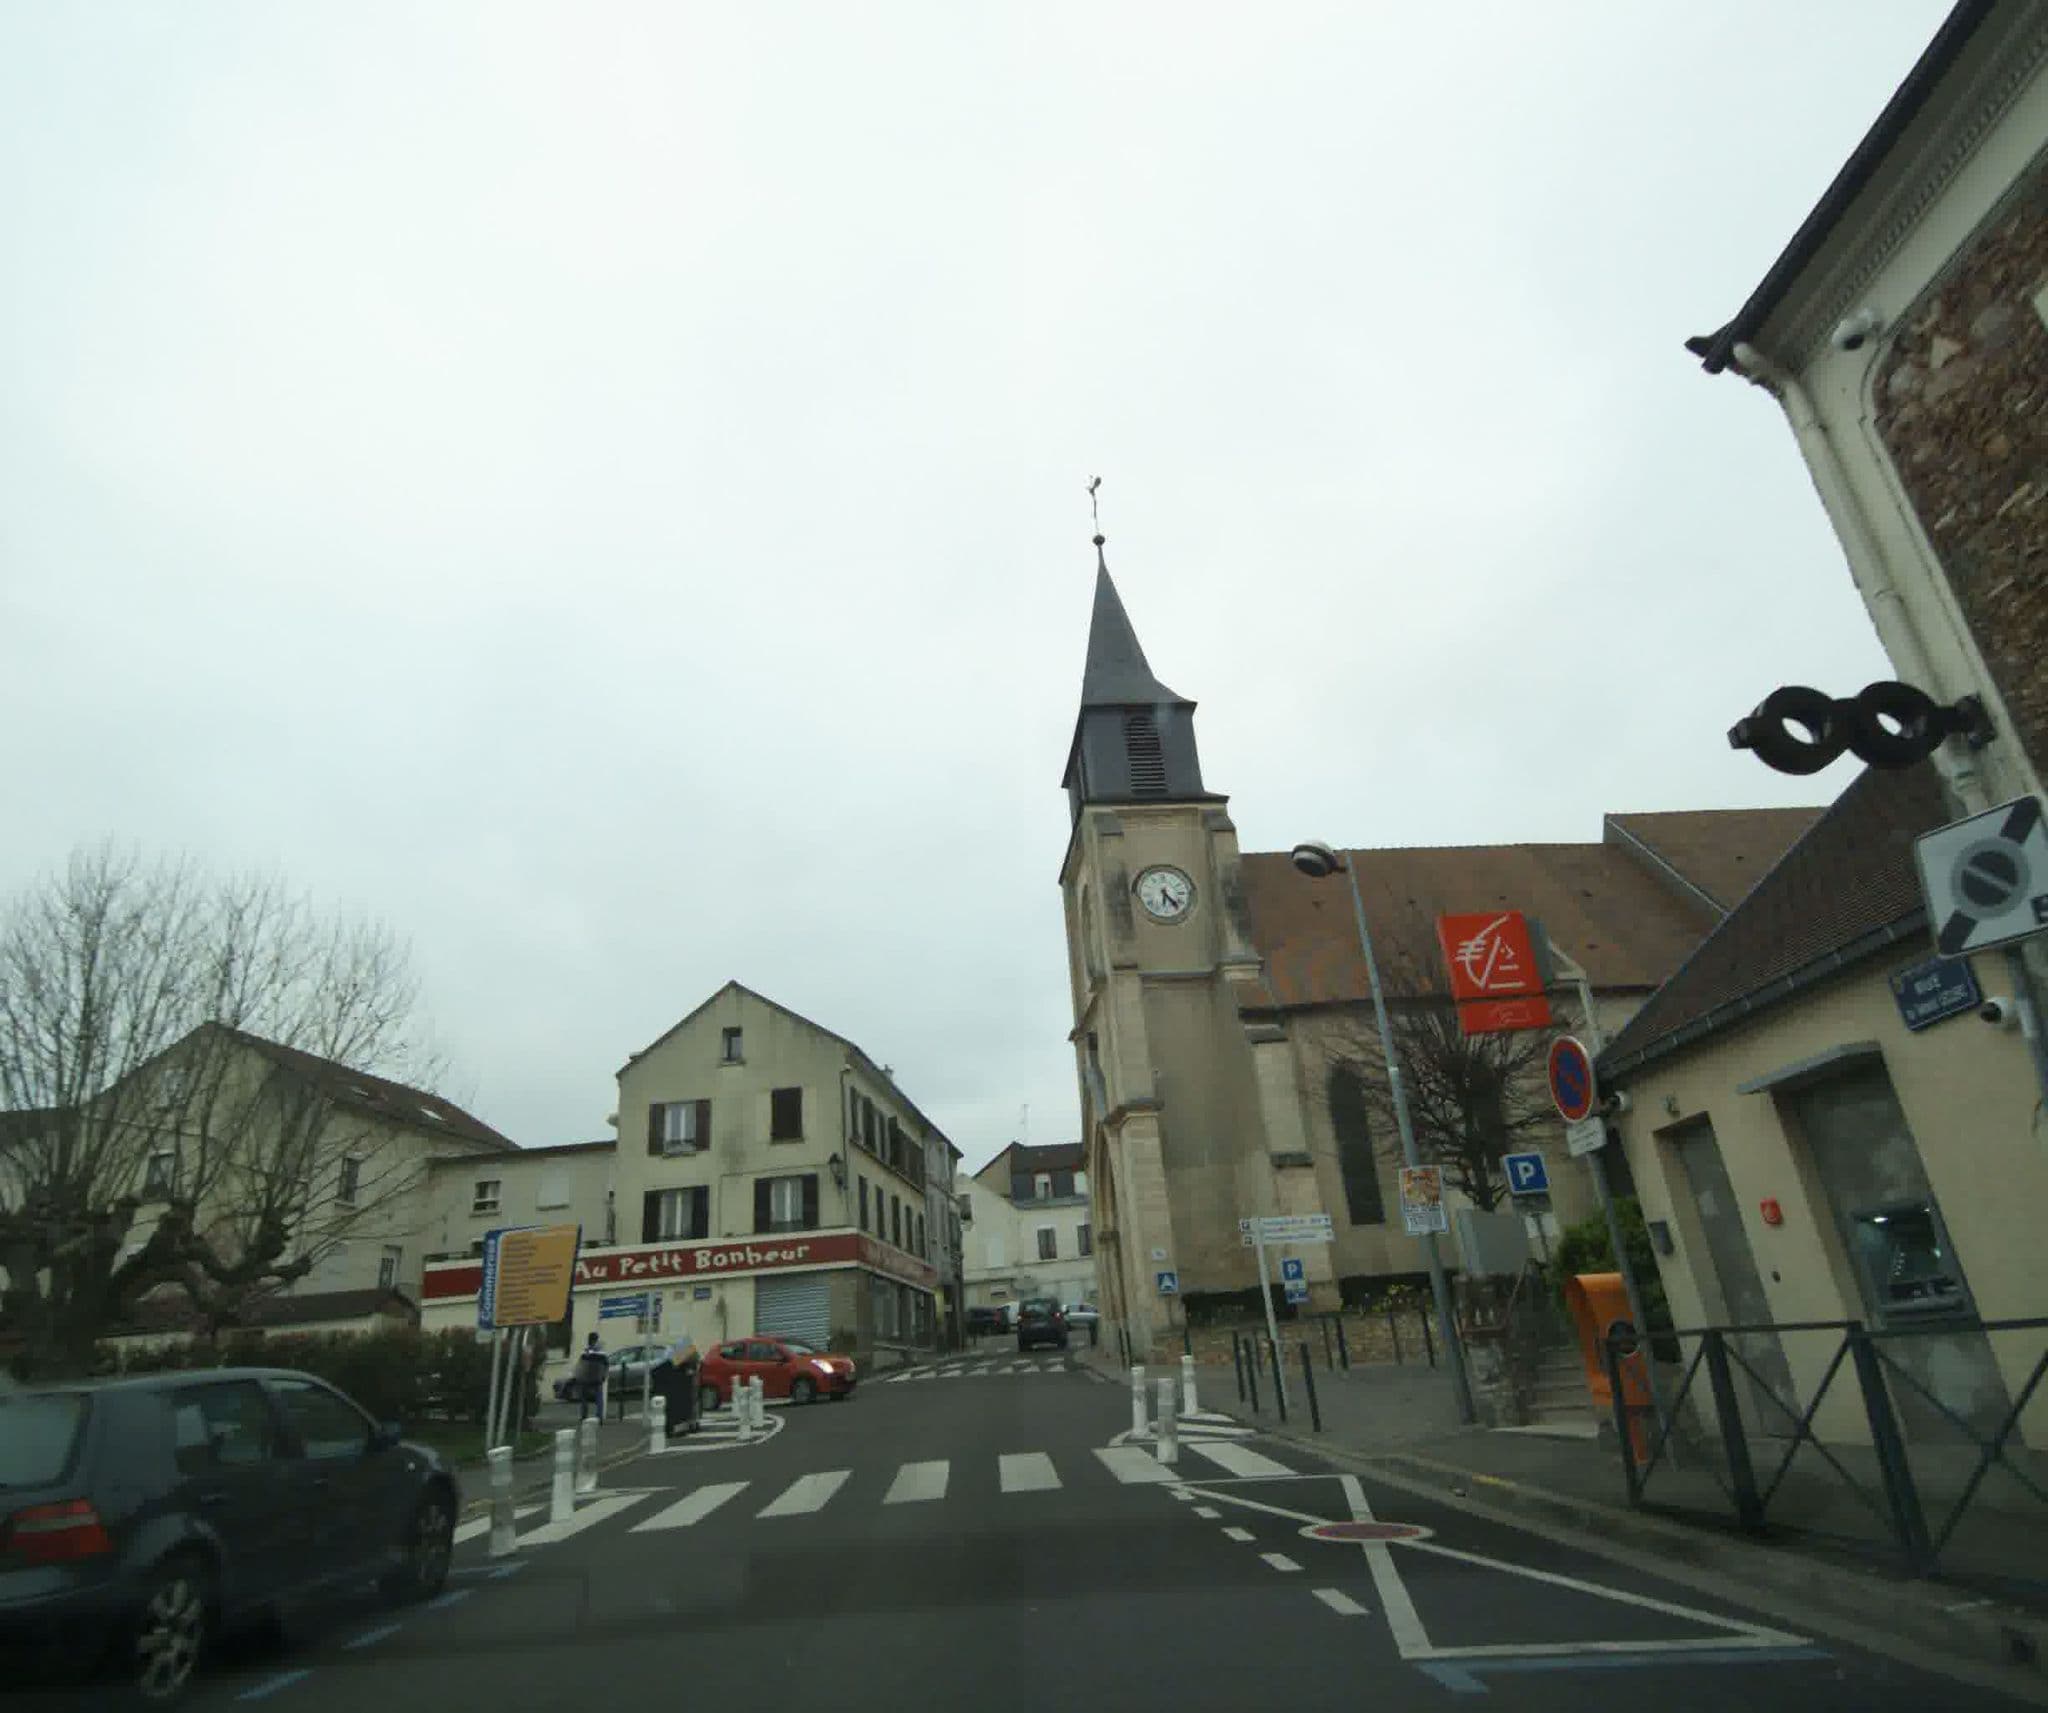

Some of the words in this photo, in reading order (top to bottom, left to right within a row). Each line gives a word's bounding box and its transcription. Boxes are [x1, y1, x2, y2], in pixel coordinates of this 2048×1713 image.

[1516, 1160, 1536, 1186] P
[575, 1260, 608, 1280] Au
[619, 1251, 683, 1276] Petit
[694, 1245, 811, 1270] Bonheur
